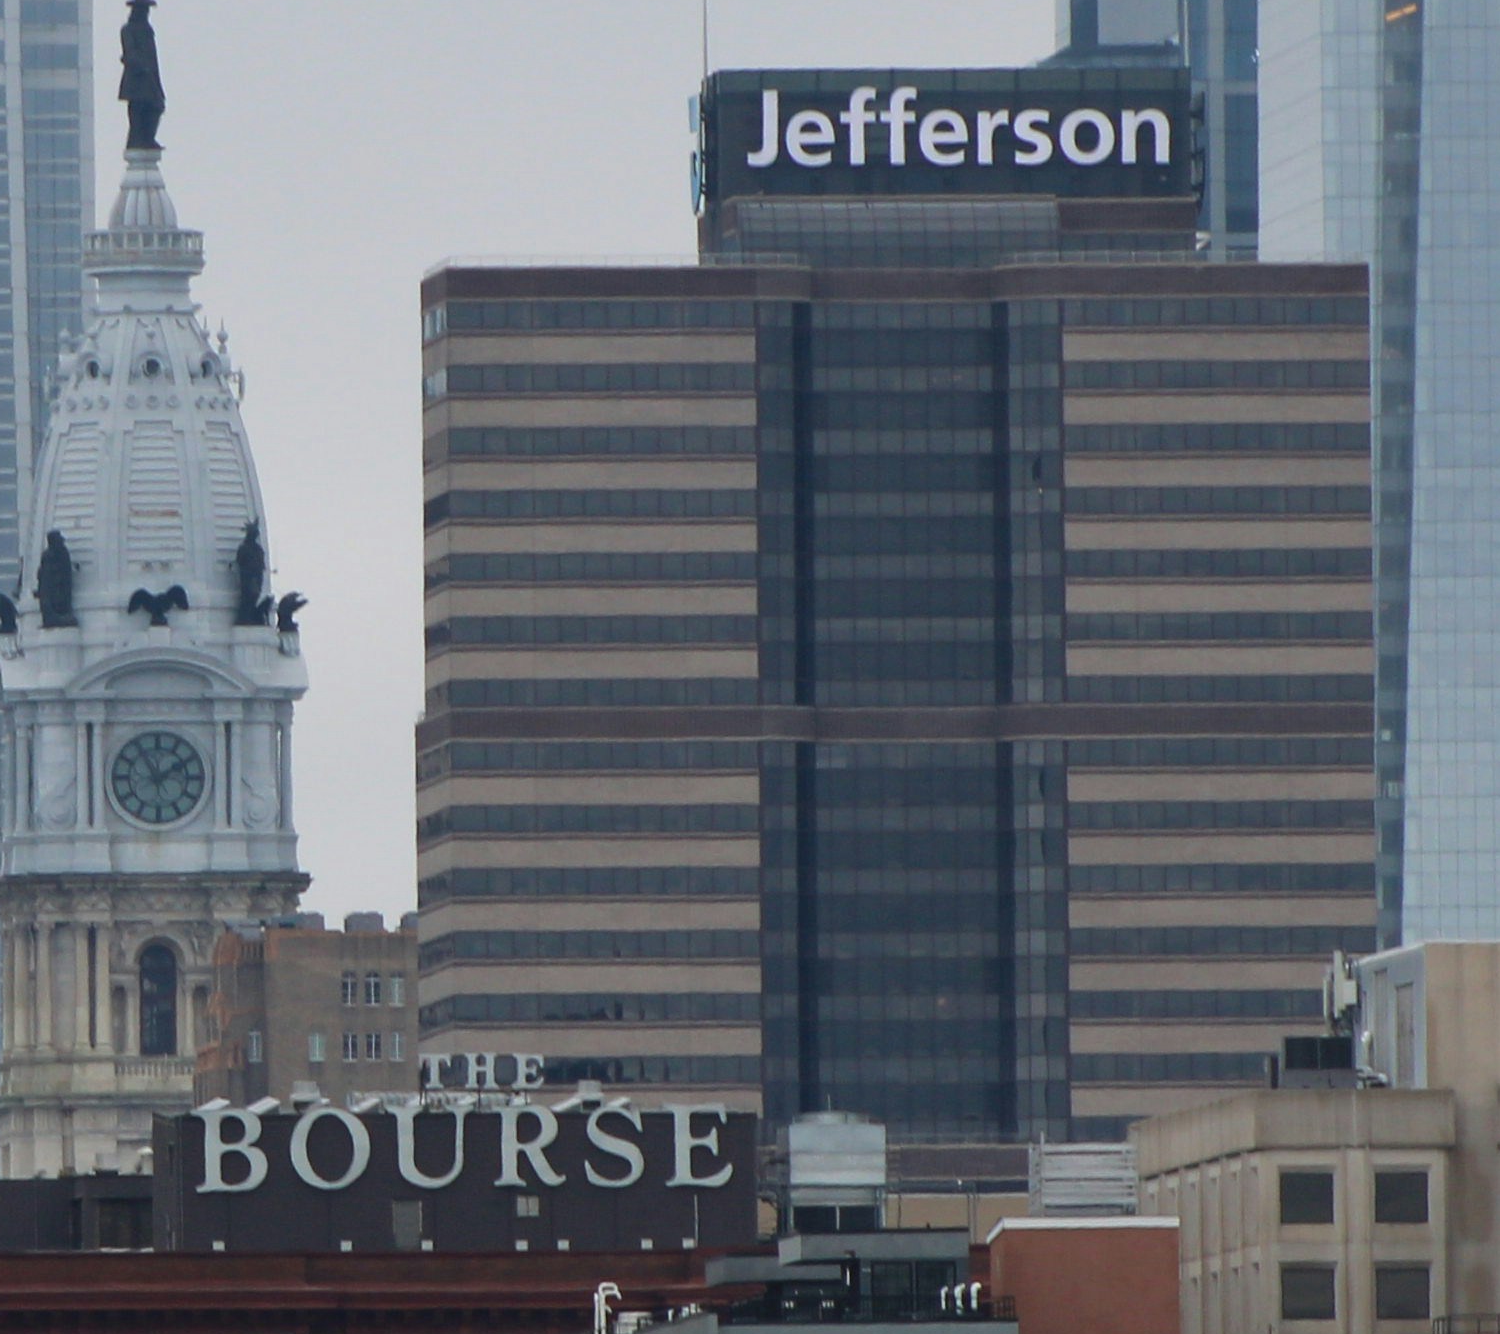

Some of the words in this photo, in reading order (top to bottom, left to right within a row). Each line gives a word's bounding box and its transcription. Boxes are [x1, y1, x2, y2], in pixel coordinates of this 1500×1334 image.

[746, 85, 1171, 167] Jefferson
[418, 1052, 545, 1090] THE
[191, 1102, 734, 1193] BOURSE
